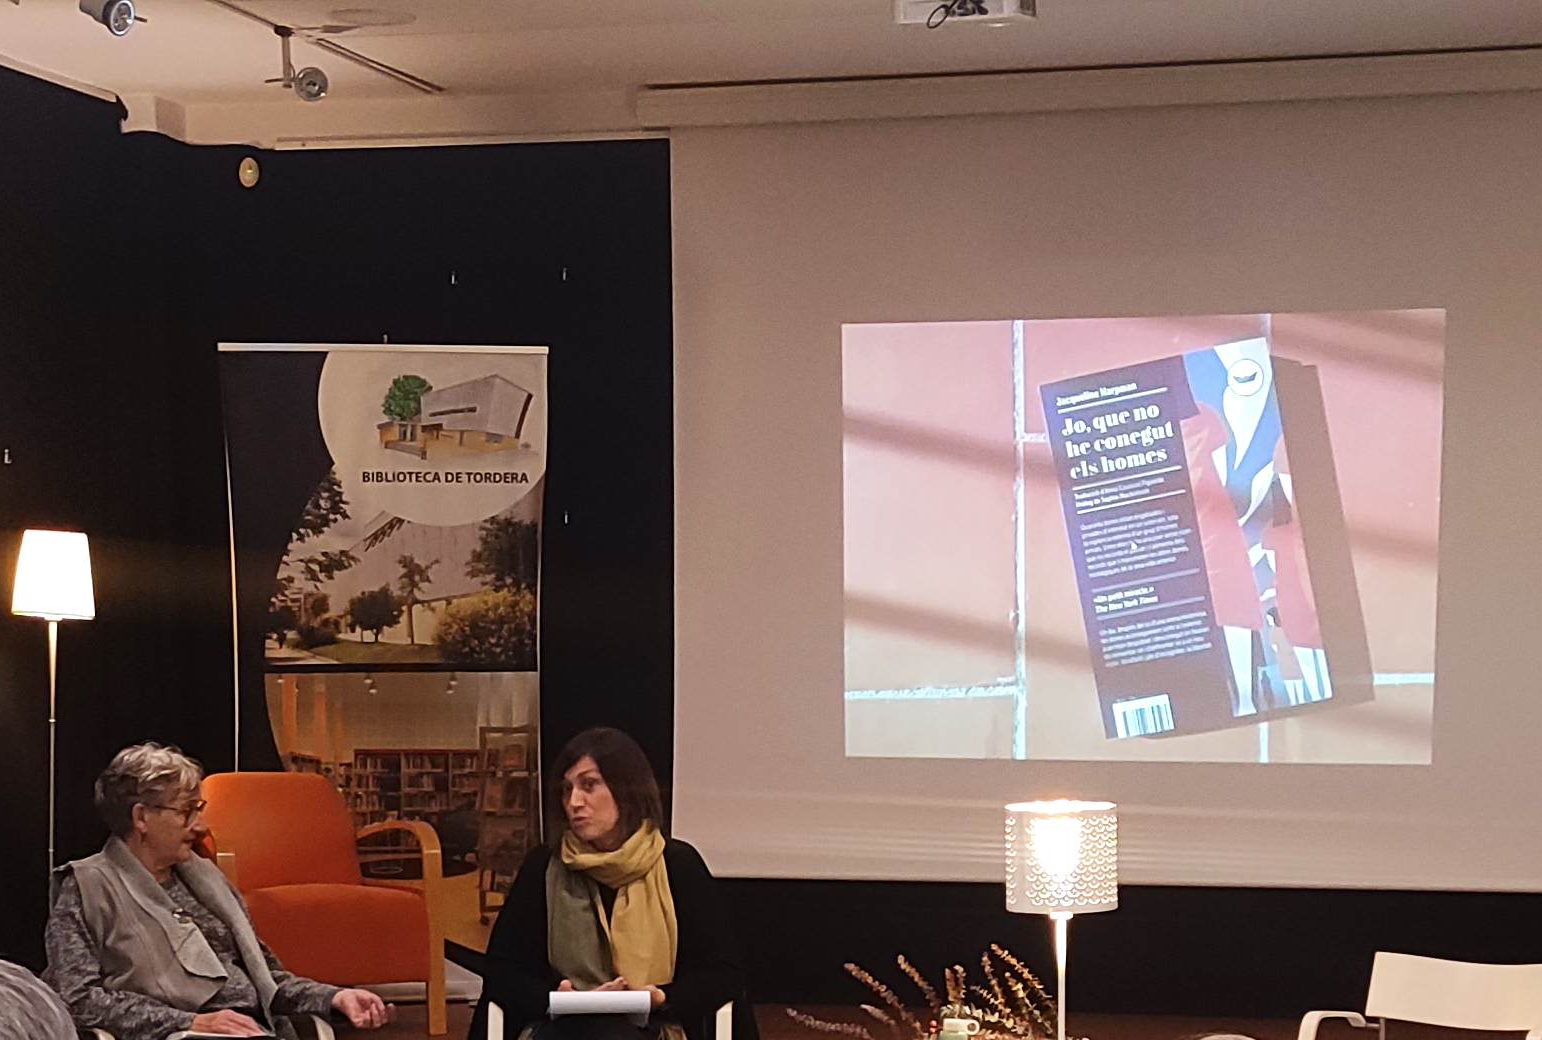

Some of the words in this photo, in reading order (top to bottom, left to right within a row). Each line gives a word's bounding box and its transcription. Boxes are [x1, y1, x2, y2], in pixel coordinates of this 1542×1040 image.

[1056, 391, 1099, 406] Jacqueline
[1062, 418, 1091, 436] Jo,
[1093, 411, 1130, 433] que
[1133, 405, 1160, 421] no
[1065, 441, 1091, 458] he
[1094, 421, 1175, 451] conegut
[1070, 461, 1099, 479] els
[1100, 448, 1168, 473] homes
[362, 471, 441, 483] BIBLIOTECA
[445, 472, 462, 483] DE
[466, 472, 528, 484] TORDERA
[1124, 599, 1138, 608] York
